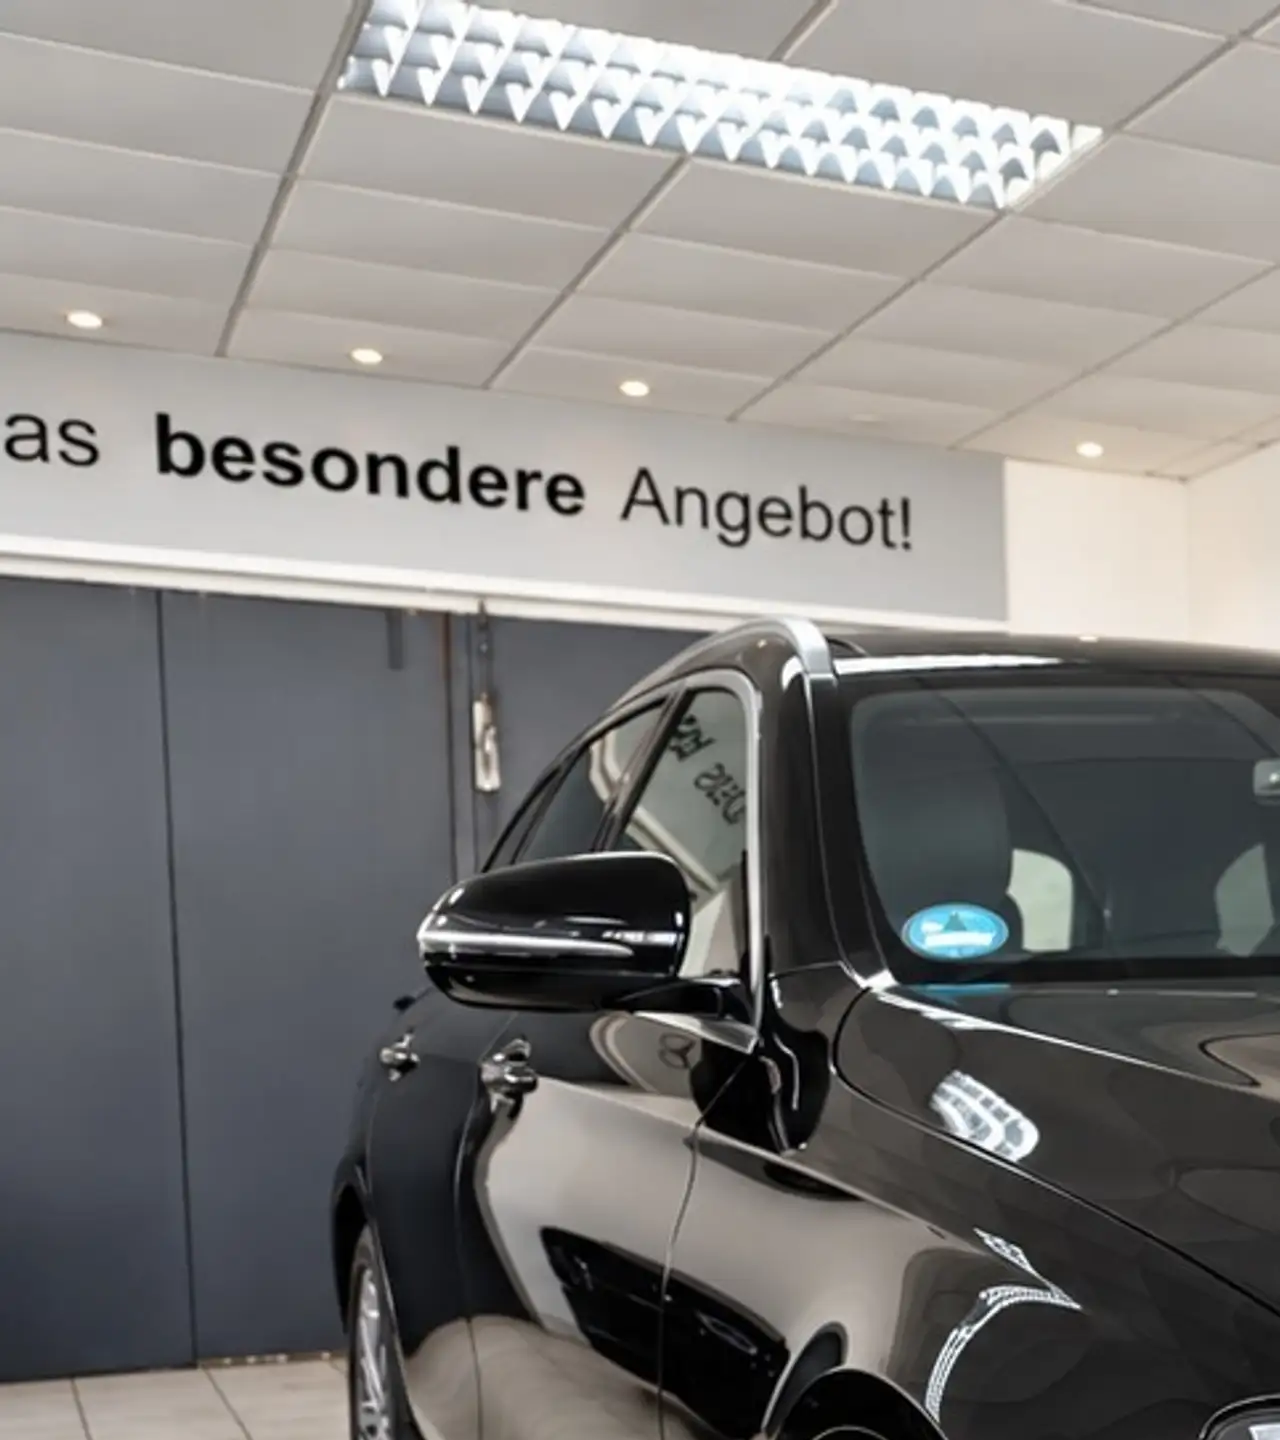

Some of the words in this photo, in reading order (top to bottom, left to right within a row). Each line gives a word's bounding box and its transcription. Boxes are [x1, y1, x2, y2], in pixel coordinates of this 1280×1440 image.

[4, 412, 100, 467] as
[155, 411, 586, 516] besondere
[620, 466, 912, 551] Angebot!
